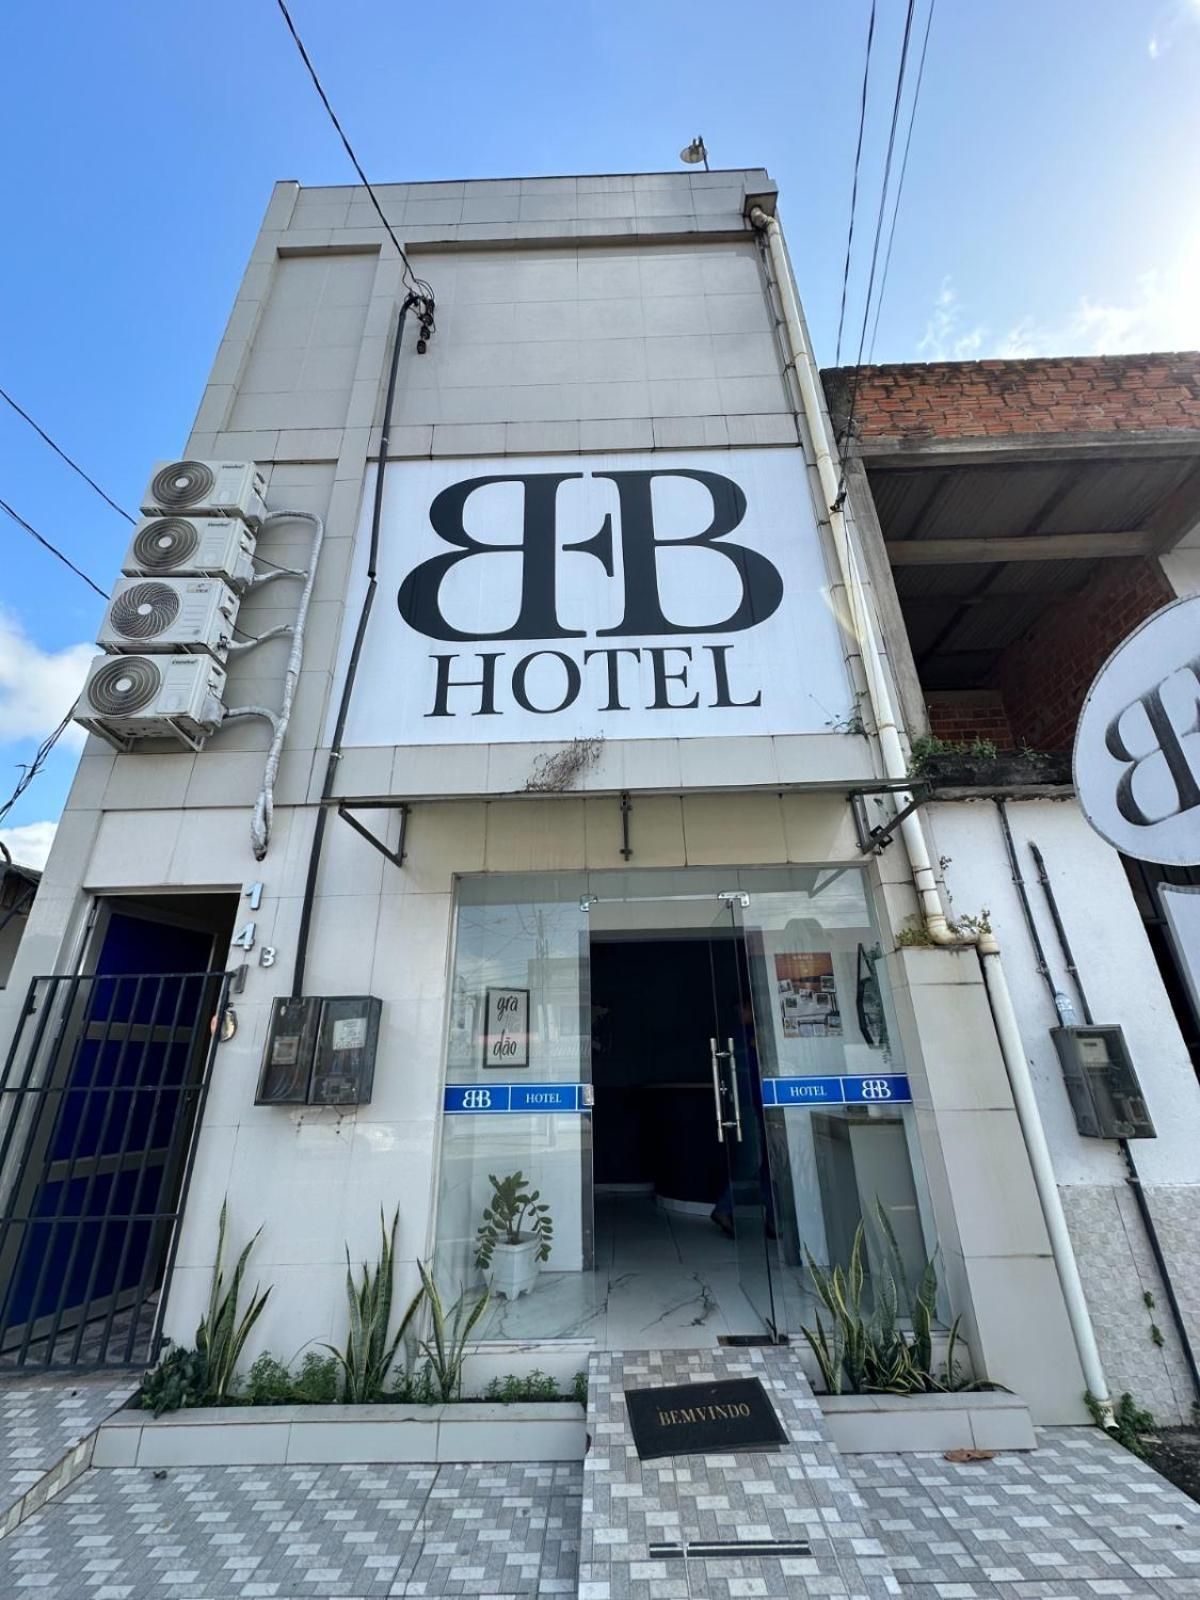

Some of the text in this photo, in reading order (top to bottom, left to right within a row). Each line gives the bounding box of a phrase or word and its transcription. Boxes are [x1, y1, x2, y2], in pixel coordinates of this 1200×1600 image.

[424, 645, 761, 717] HOTEL
[526, 1093, 562, 1104] HOTEL
[790, 1086, 827, 1097] HOTEL
[659, 1403, 750, 1426] BEMVINDO
